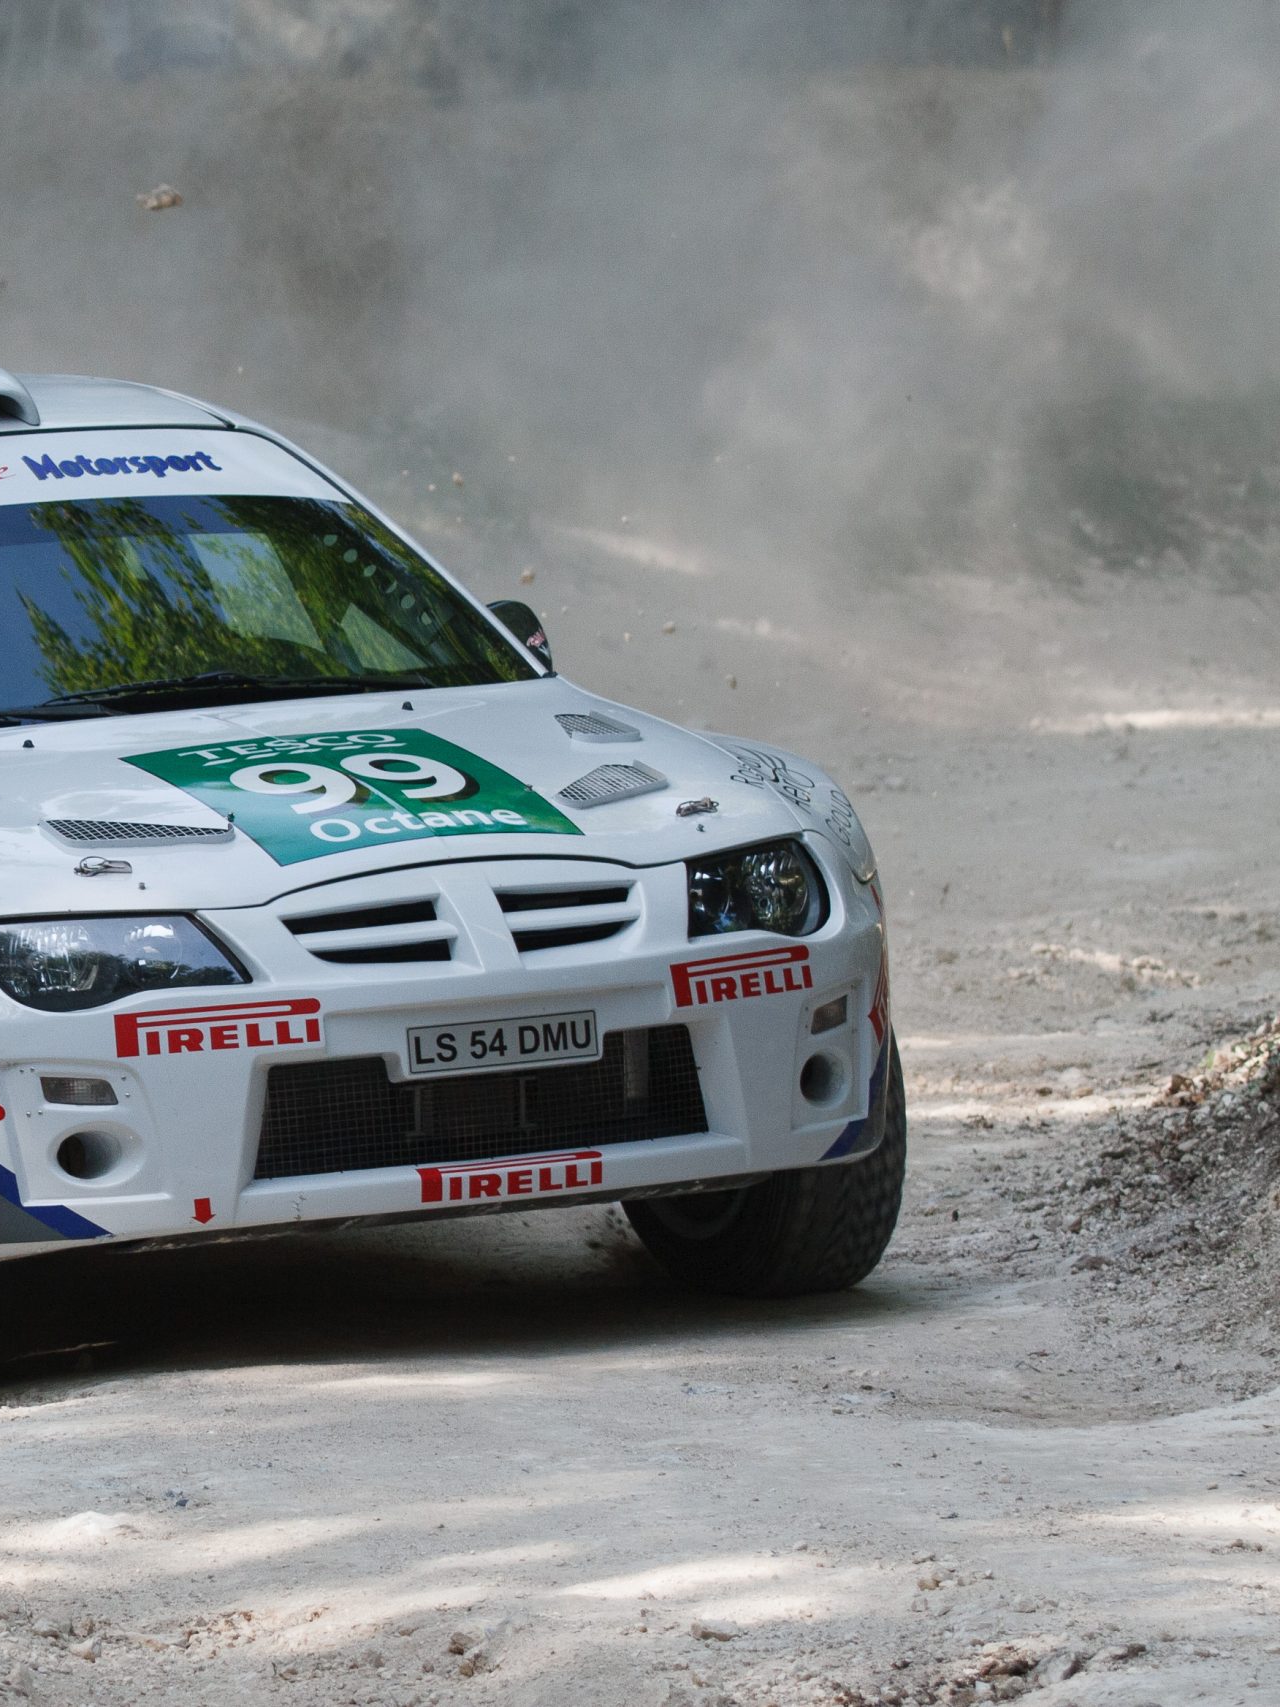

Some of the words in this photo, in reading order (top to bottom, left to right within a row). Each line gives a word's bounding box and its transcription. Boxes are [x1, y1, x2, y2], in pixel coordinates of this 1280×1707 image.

[21, 451, 222, 480] Motorsport
[177, 733, 397, 761] TESCO
[229, 752, 470, 815] 99
[310, 808, 527, 842] Octane
[670, 945, 812, 1007] PIRELLI
[114, 998, 320, 1057] PIRELLI
[414, 1033, 458, 1064] LS
[470, 1028, 507, 1059] 54
[518, 1019, 592, 1054] DMU
[417, 1151, 602, 1202] PIRELLI
